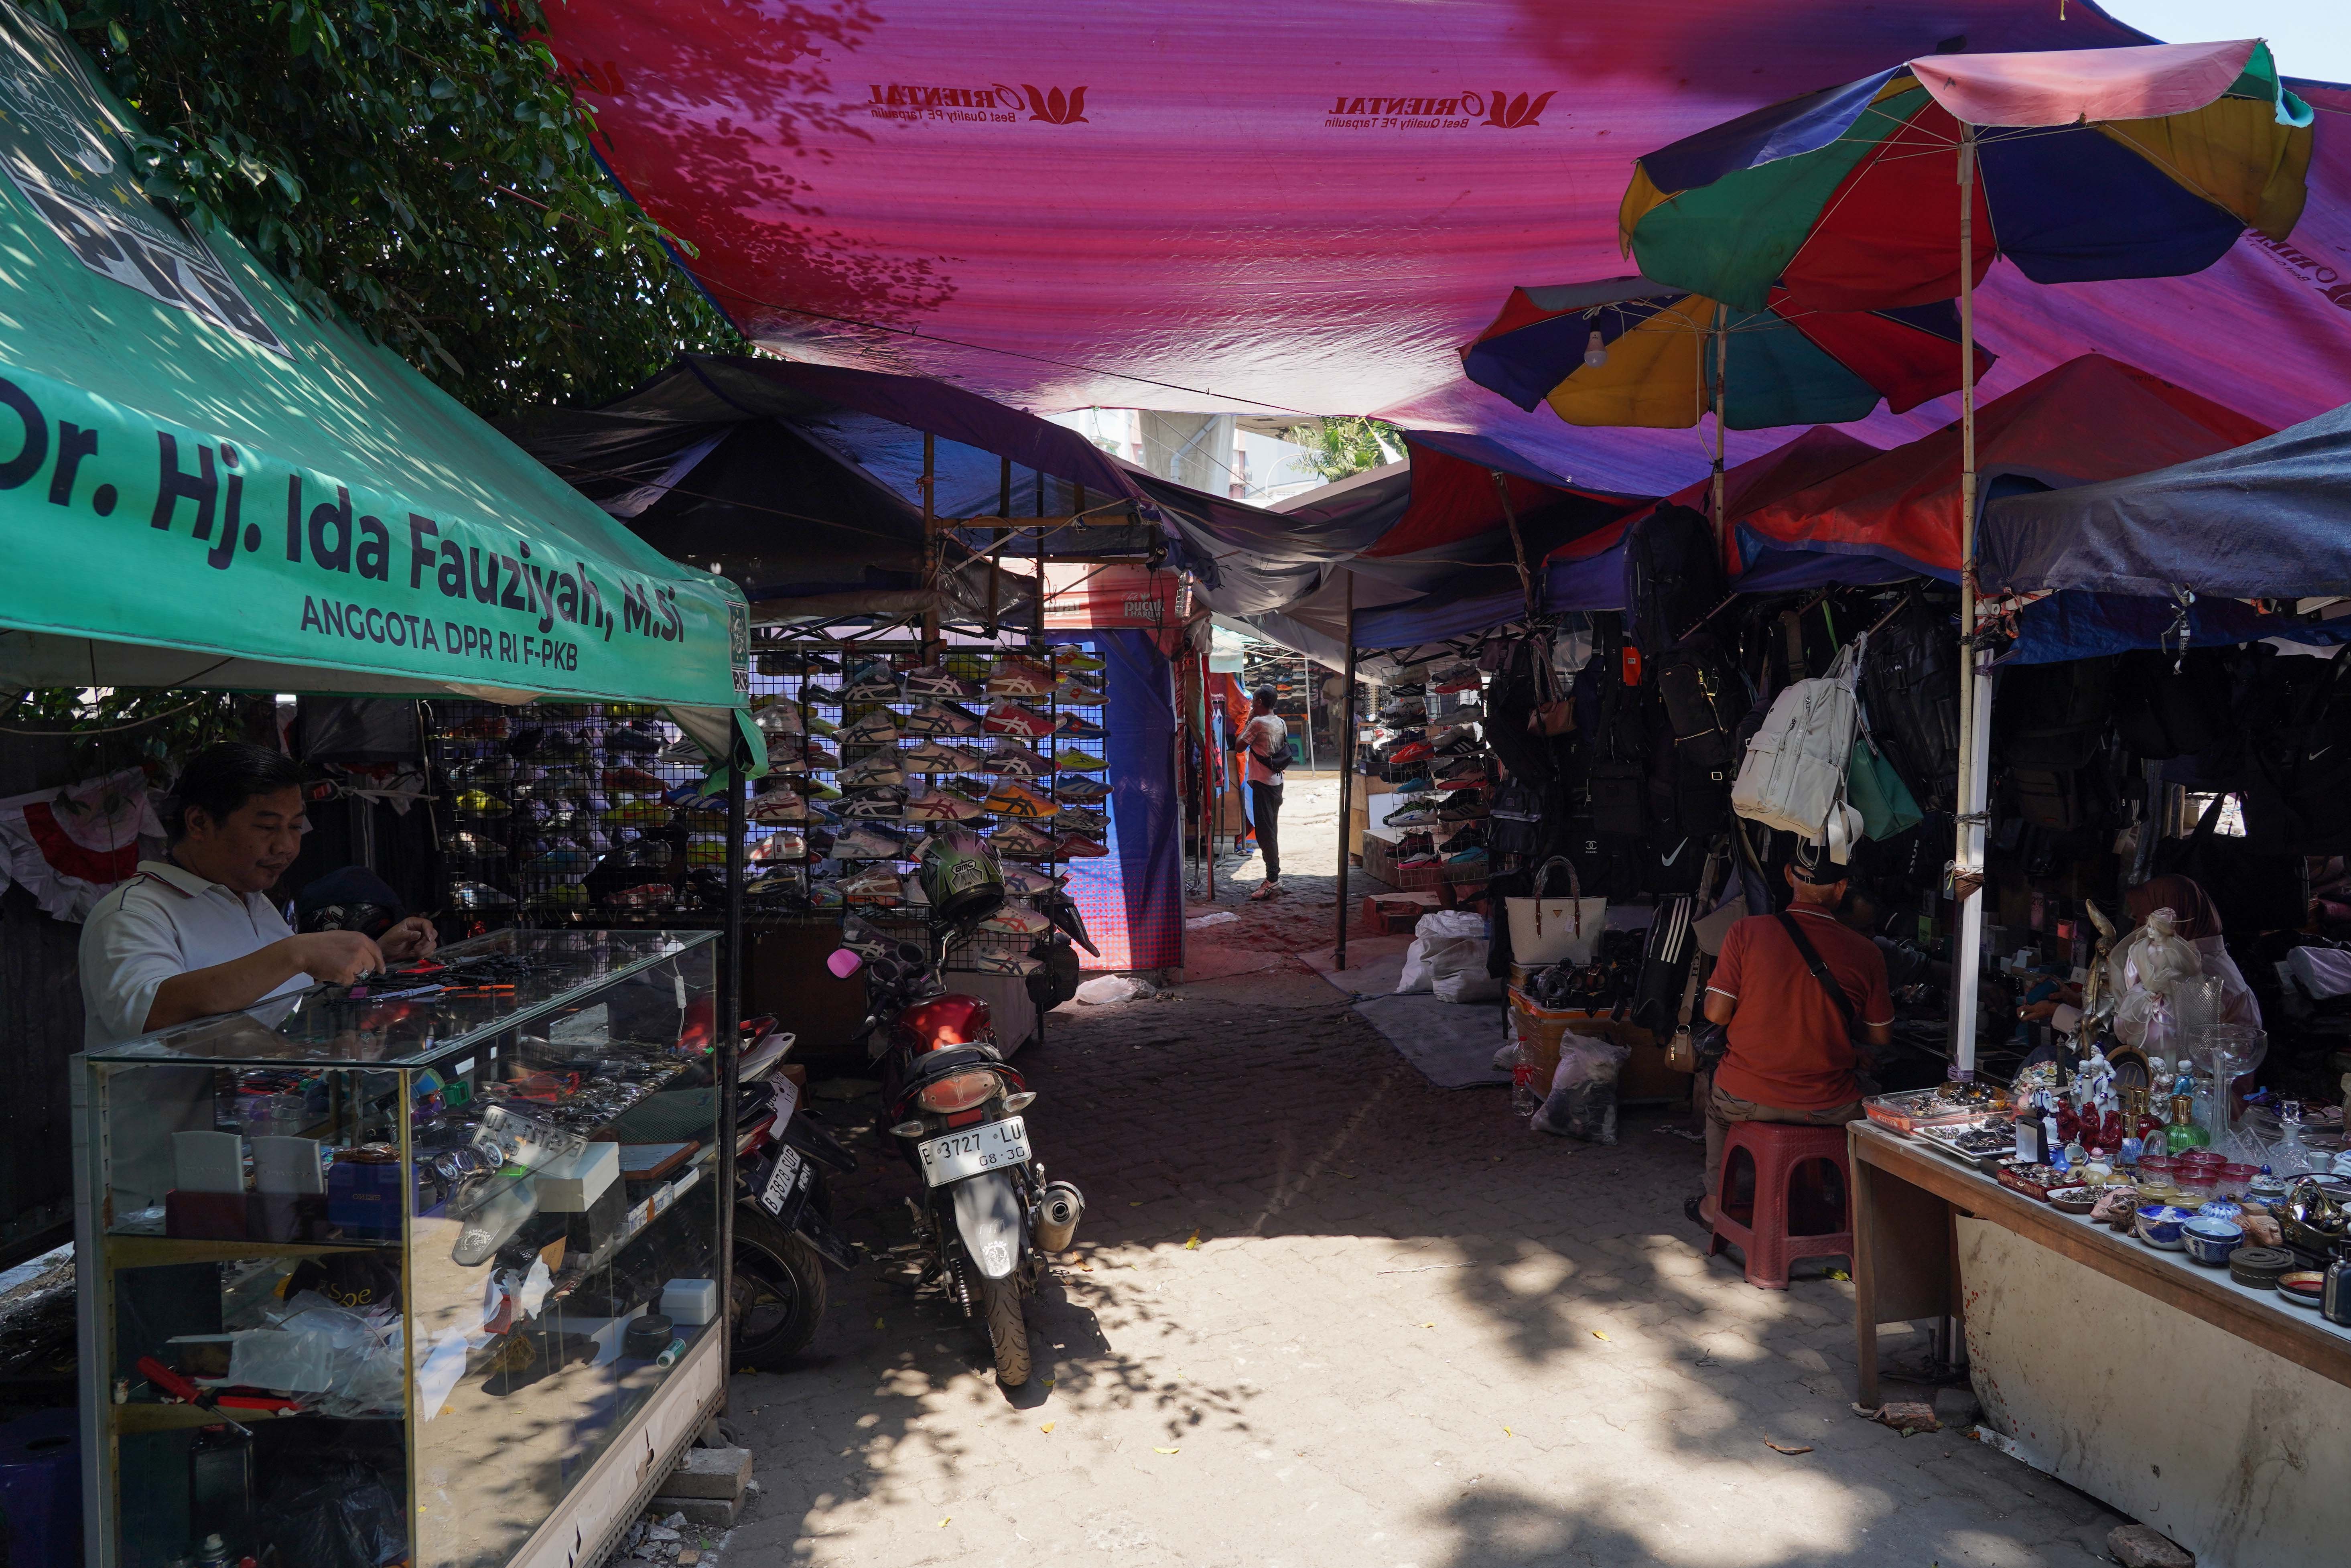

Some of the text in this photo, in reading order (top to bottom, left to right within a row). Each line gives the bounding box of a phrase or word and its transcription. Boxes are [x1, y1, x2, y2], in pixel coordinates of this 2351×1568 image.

[23, 186, 279, 347] PKB
[151, 430, 262, 570] Hj.
[286, 473, 390, 583] Ida
[408, 512, 613, 642] Fauziyah,
[621, 578, 684, 643] M.Si
[300, 595, 578, 672] ANGGOTA DPR RI F-PKB
[955, 861, 973, 873] BMC
[940, 1133, 981, 1159] 3727
[1000, 1123, 1021, 1143] LU
[765, 1148, 798, 1211] B 3878 SUP
